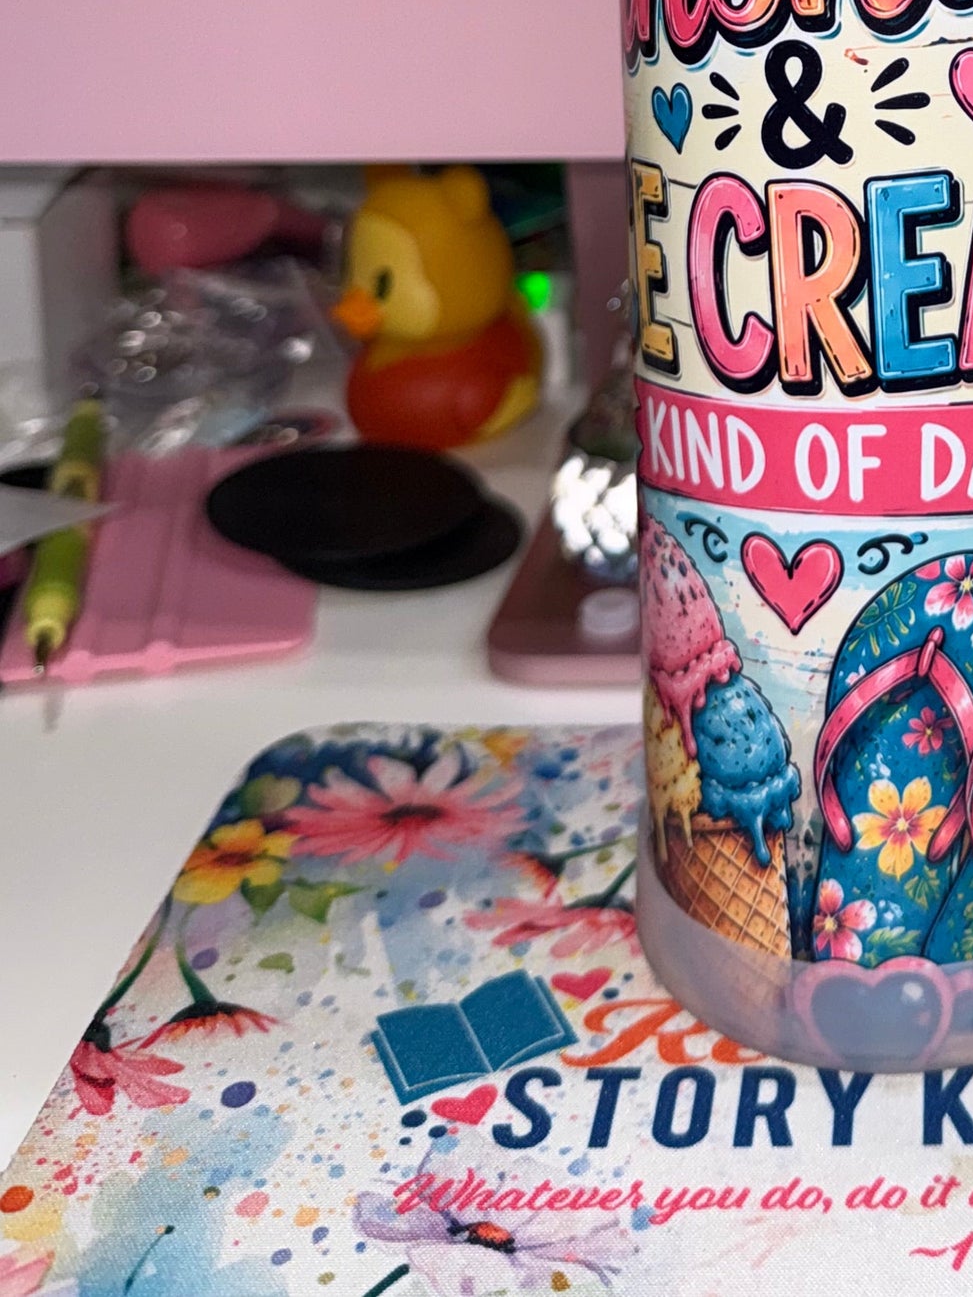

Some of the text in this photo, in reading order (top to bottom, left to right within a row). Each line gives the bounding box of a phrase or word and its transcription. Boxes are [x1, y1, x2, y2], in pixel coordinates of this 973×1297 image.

[760, 39, 855, 167] &
[644, 395, 767, 496] KIND
[794, 423, 888, 502] OF
[491, 1065, 874, 1150] STORY
[393, 1167, 646, 1216] Whatever
[648, 1182, 750, 1226] you
[760, 1176, 833, 1216] do,
[845, 1175, 907, 1211] do
[918, 1173, 963, 1209] it
